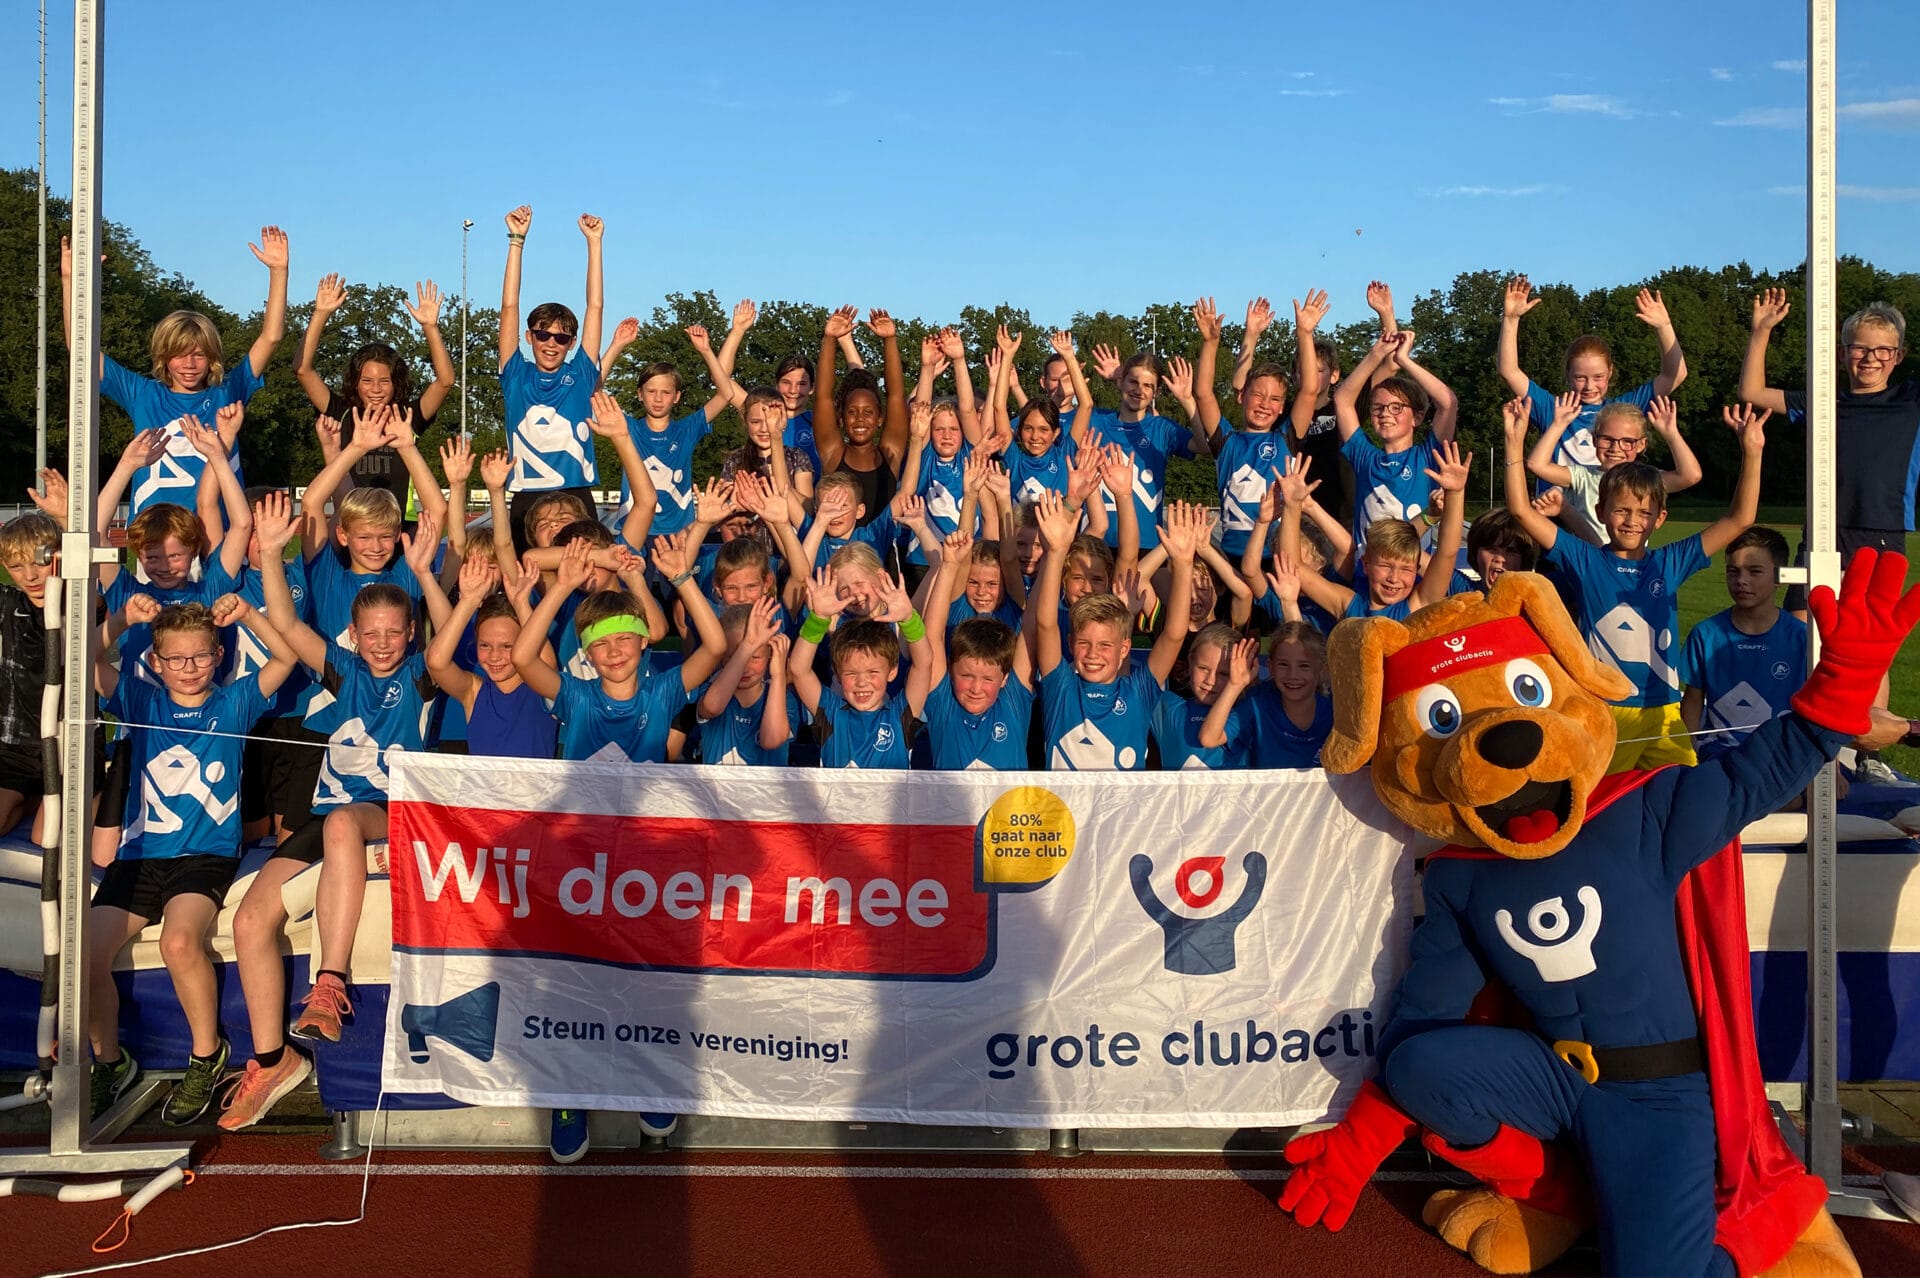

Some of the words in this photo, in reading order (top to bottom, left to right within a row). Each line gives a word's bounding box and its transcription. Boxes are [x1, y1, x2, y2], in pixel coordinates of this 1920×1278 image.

[1431, 658, 1454, 673] grote
[1455, 650, 1494, 662] clubactie
[173, 711, 199, 719] CRAFT
[1010, 814, 1043, 827] 80%
[990, 830, 1025, 844] gaat
[1029, 830, 1062, 842] naar
[994, 846, 1031, 857] onze
[1035, 844, 1067, 858] club
[412, 840, 530, 918] Wij
[558, 852, 754, 923] doen
[783, 877, 950, 927] mee
[522, 1015, 605, 1041] Steun
[614, 1023, 681, 1045] onze
[690, 1032, 849, 1063] vereniging!
[986, 1024, 1140, 1079] grote
[1160, 1011, 1387, 1066] clubacti
